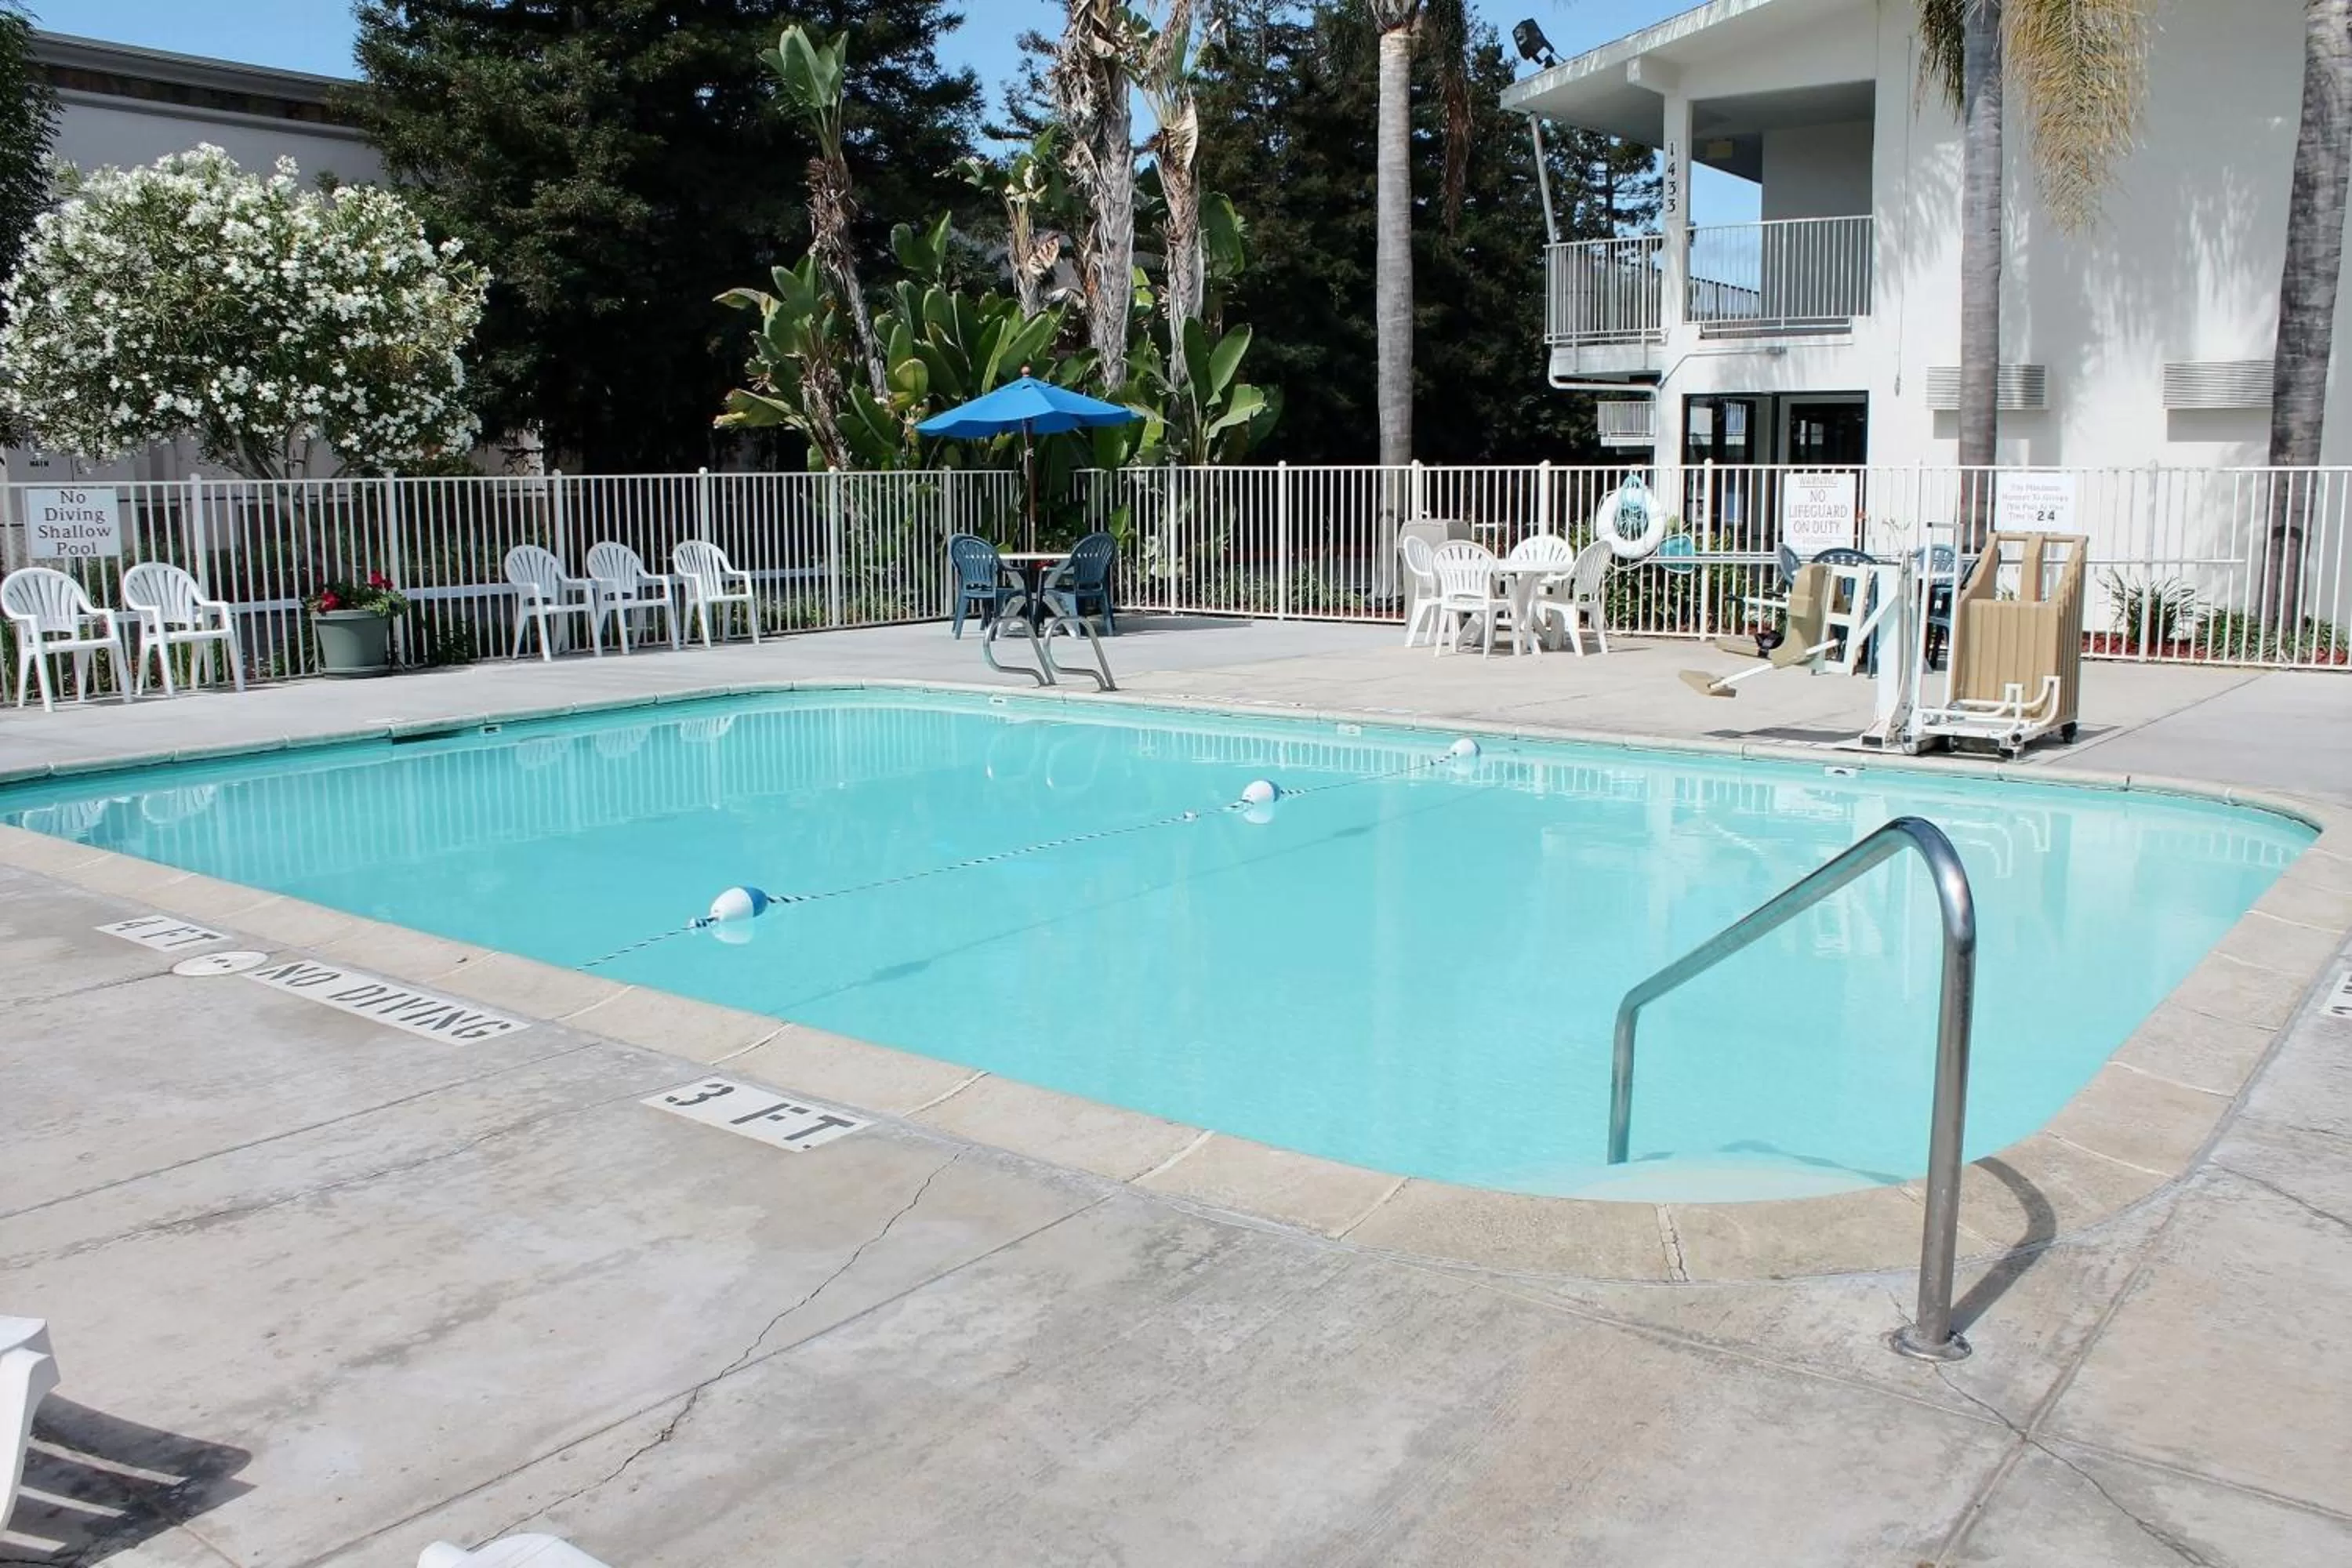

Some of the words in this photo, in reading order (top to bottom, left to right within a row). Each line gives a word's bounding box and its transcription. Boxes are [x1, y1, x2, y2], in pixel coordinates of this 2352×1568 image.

[1668, 141, 1677, 212] 1433
[60, 490, 86, 504] No
[1809, 488, 1826, 503] NO
[44, 507, 106, 524] Diving
[1788, 504, 1848, 518] LIFEGUARD
[2037, 510, 2056, 521] 24
[38, 524, 112, 539] Shallow
[1793, 520, 1811, 534] ON
[1813, 520, 1842, 534] DUTY
[56, 541, 97, 555] Pool
[115, 920, 165, 931] 4
[140, 926, 222, 948] FT
[256, 963, 342, 988] NO
[325, 984, 512, 1039] DIVING
[665, 1083, 735, 1106] 3
